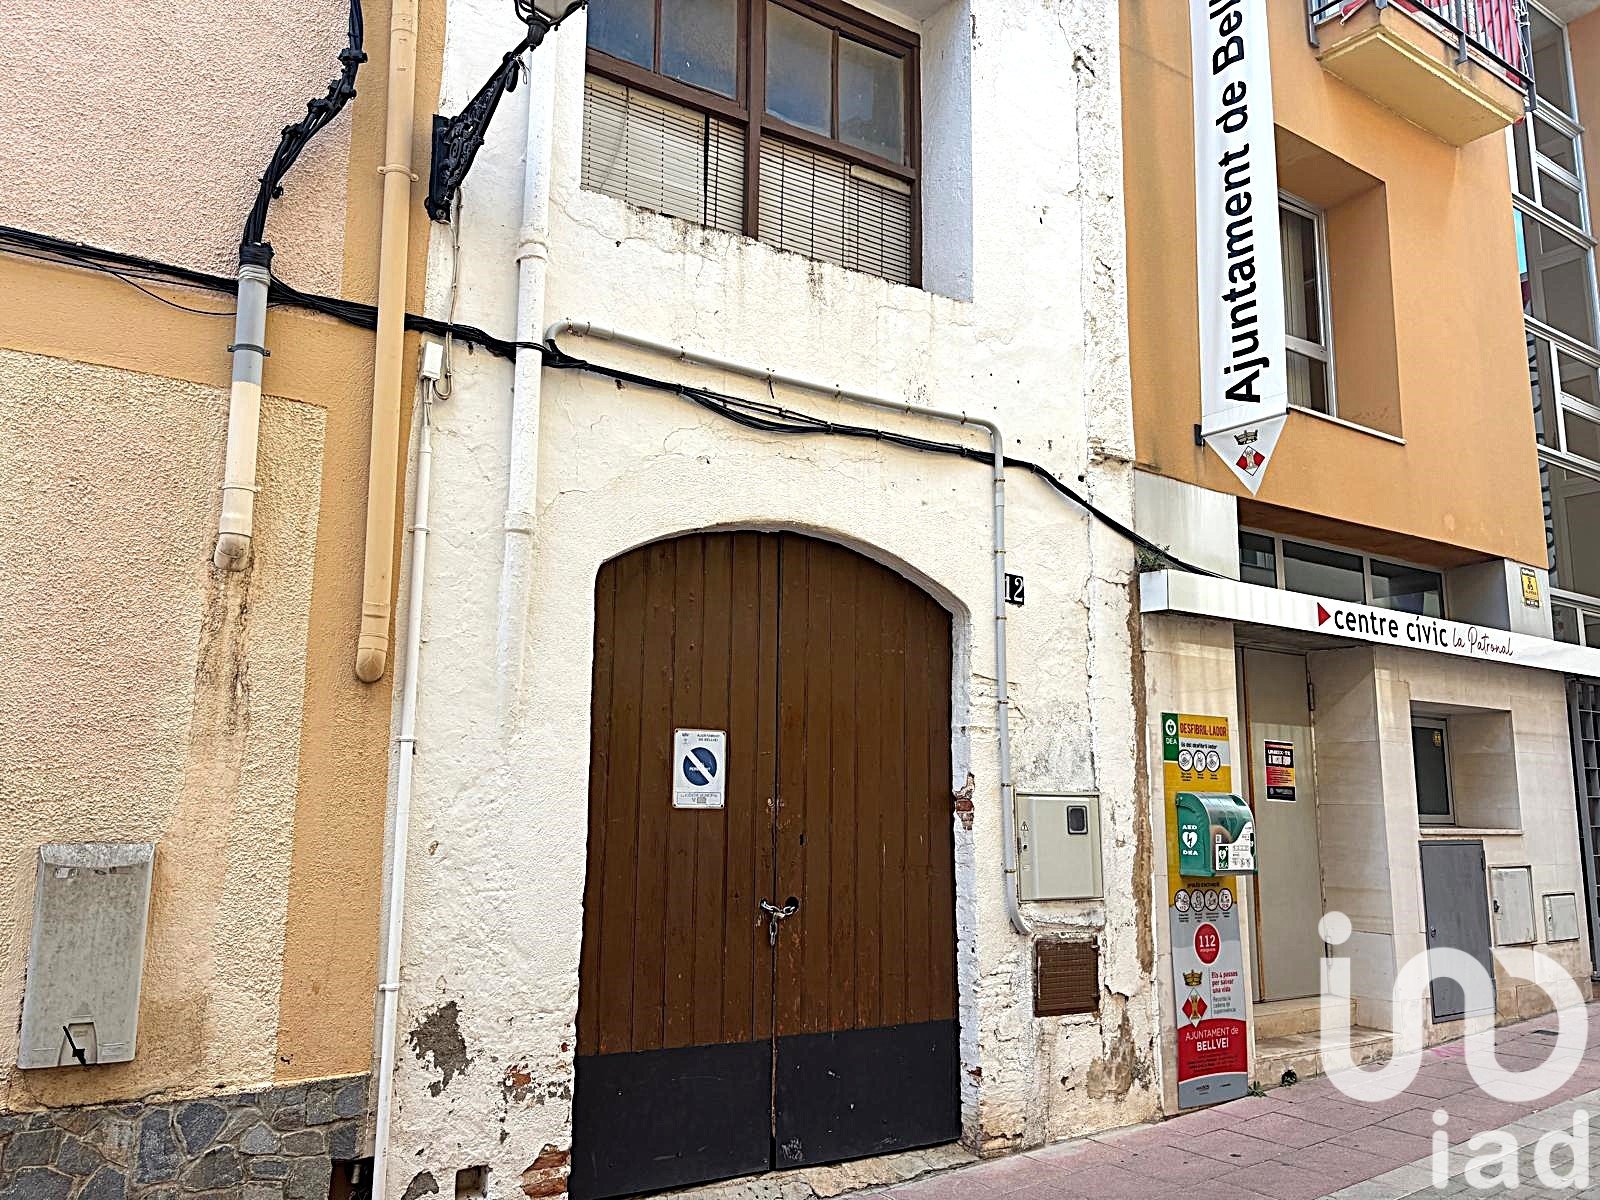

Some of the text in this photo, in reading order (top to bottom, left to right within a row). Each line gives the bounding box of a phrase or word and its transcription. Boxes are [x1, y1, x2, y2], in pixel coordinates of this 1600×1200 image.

[1209, 0, 1270, 403] Ajuntament de Bel
[1004, 575, 1024, 602] 12
[1334, 609, 1513, 656] centre cívic la Patronal
[1165, 737, 1177, 745] DEA
[1199, 934, 1216, 948] 112
[1185, 1026, 1239, 1041] AJUNTAMENT de
[1196, 1037, 1229, 1051] BELLVEI
